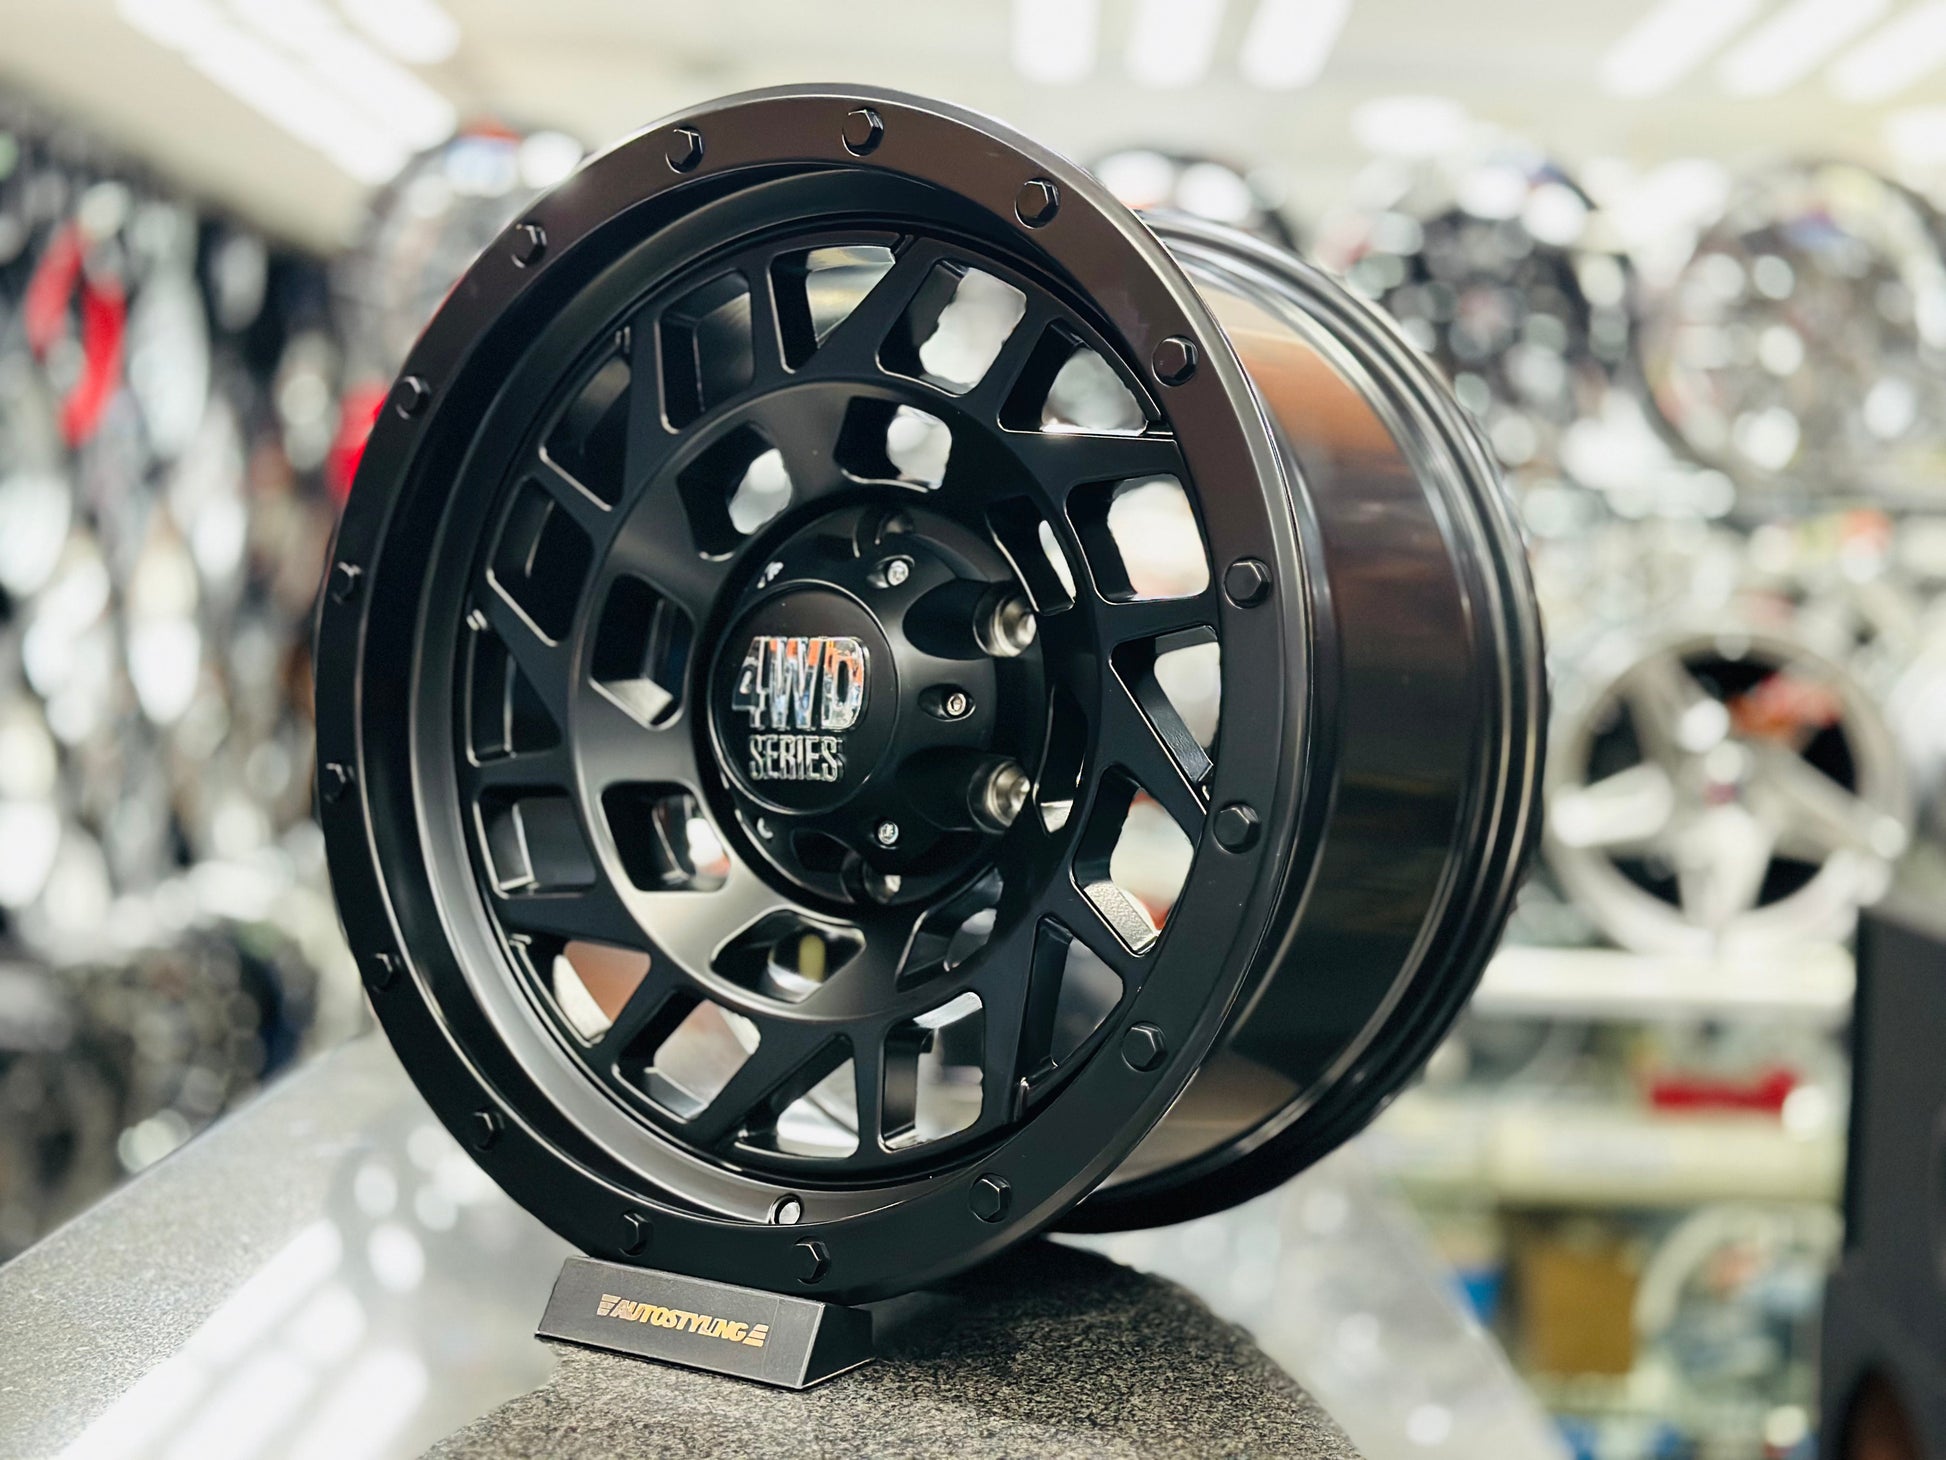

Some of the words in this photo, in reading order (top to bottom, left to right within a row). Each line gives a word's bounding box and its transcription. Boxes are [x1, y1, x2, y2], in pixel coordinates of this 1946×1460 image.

[732, 636, 868, 731] 4WD
[749, 734, 842, 782] SERIES
[610, 1299, 748, 1342] AUTOSTYLING
